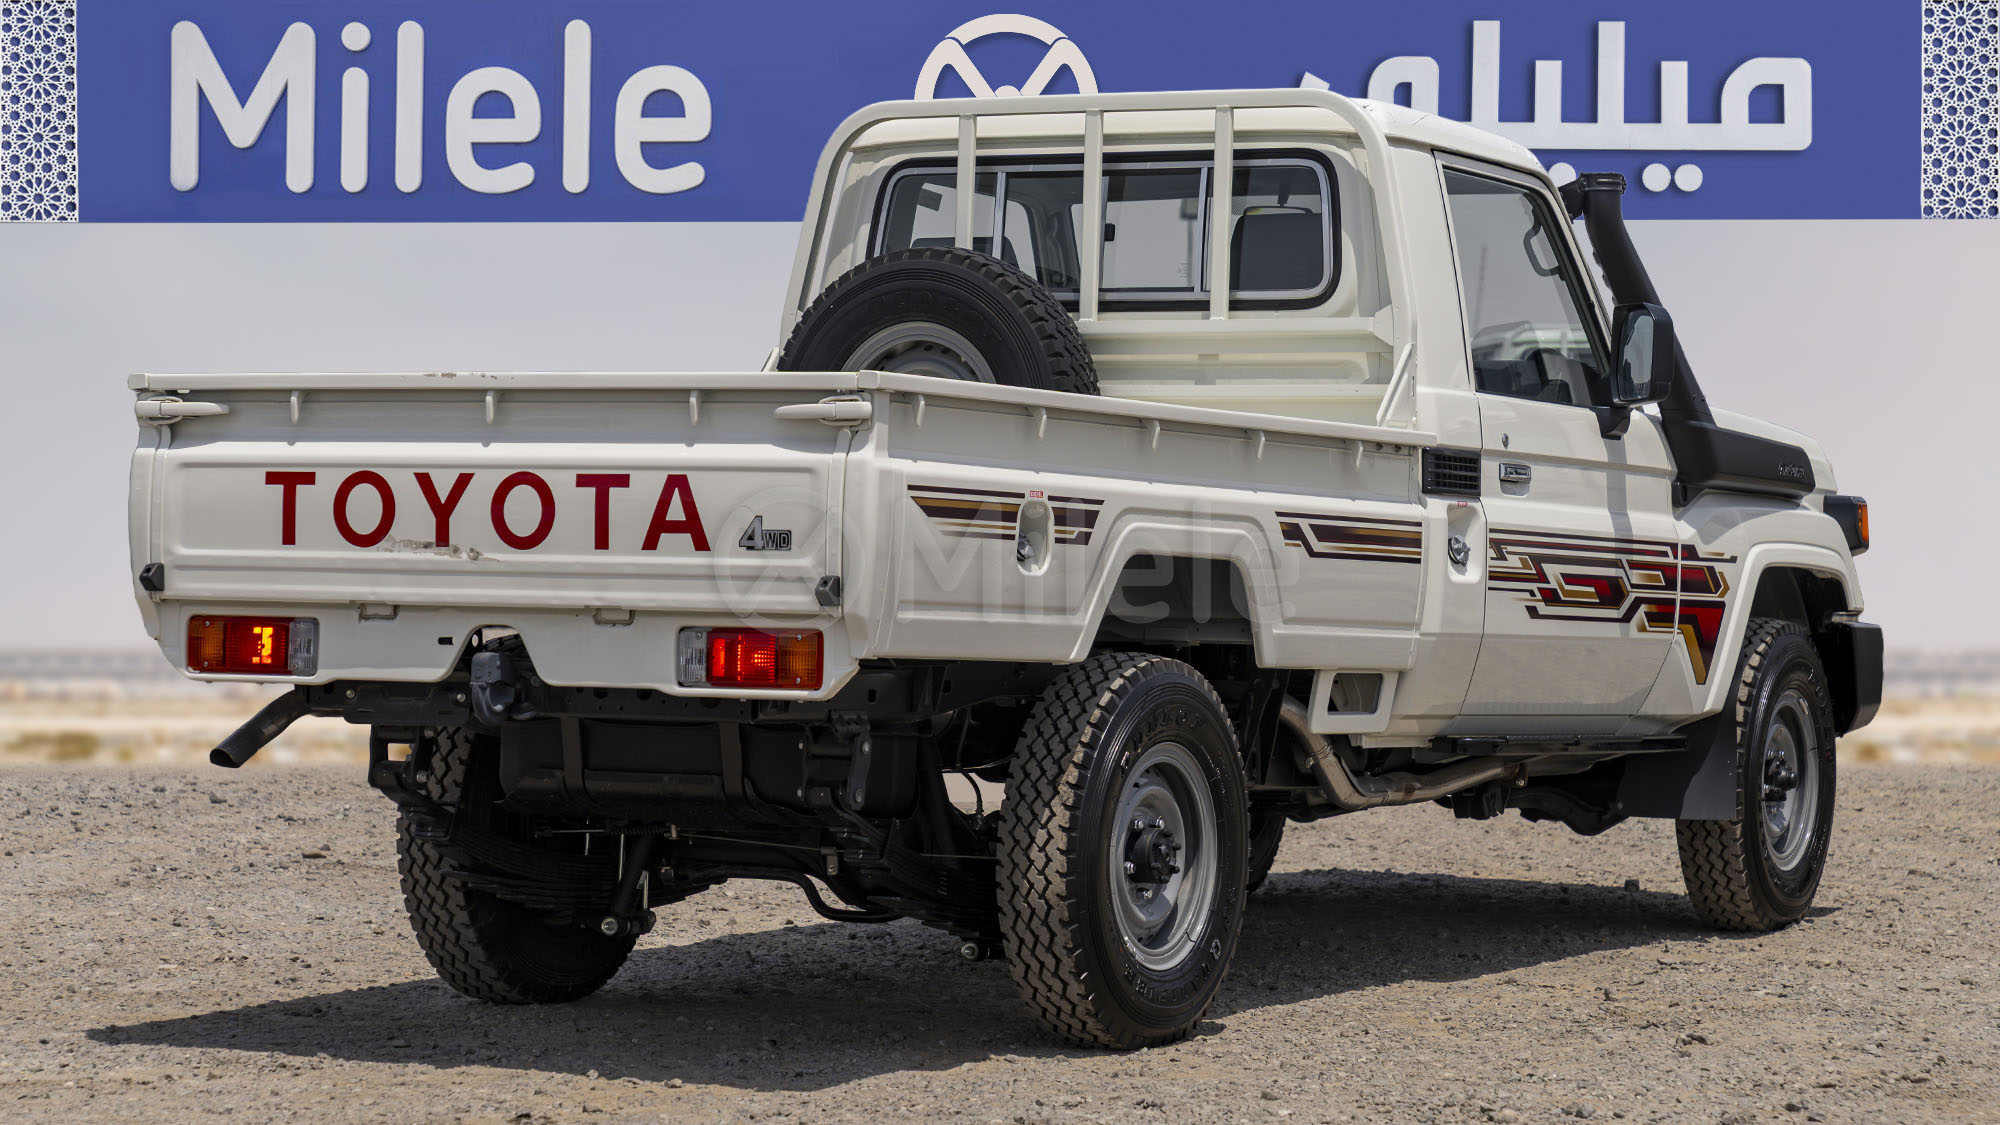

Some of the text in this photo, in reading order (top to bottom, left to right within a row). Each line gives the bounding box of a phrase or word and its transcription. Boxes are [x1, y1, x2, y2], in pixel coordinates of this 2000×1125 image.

[170, 19, 712, 194] Milele
[265, 470, 711, 552] TOYOTA
[739, 515, 792, 551] 4WD
